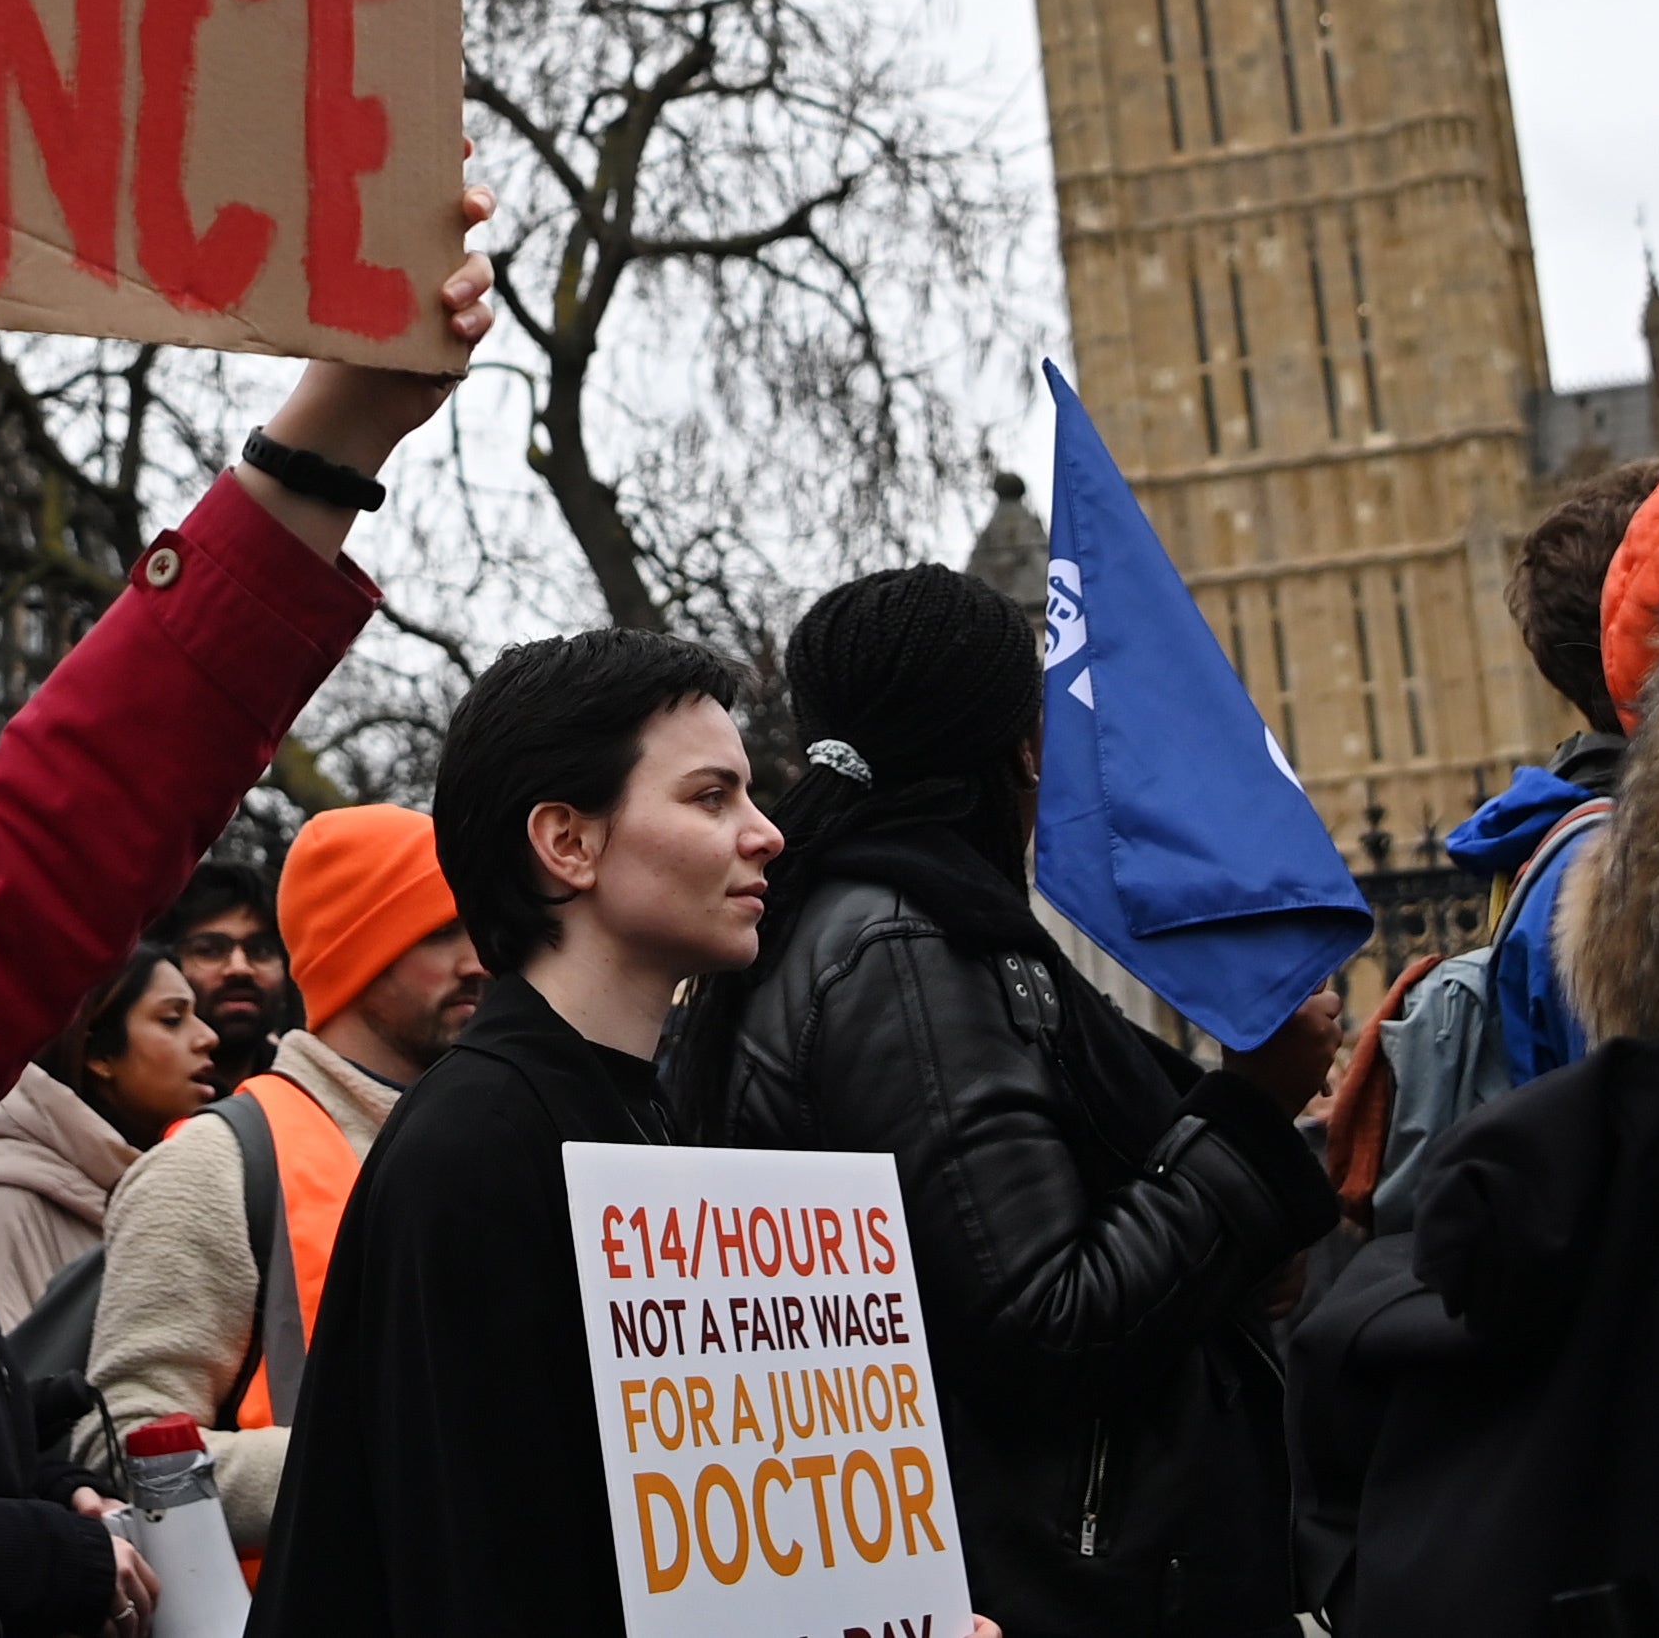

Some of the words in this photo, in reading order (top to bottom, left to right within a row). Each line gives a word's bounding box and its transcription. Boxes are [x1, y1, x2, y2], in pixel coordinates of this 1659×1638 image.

[601, 1197, 849, 1280] £14/HOUR
[852, 1206, 896, 1275] IS
[609, 1299, 686, 1358] NOT
[701, 1298, 726, 1354] A
[729, 1296, 809, 1353] FAIR
[810, 1292, 910, 1348] WAGE
[620, 1375, 720, 1453] FOR
[732, 1373, 764, 1444] A
[767, 1363, 925, 1454] JUNIOR
[633, 1445, 946, 1594] DOCTOR
